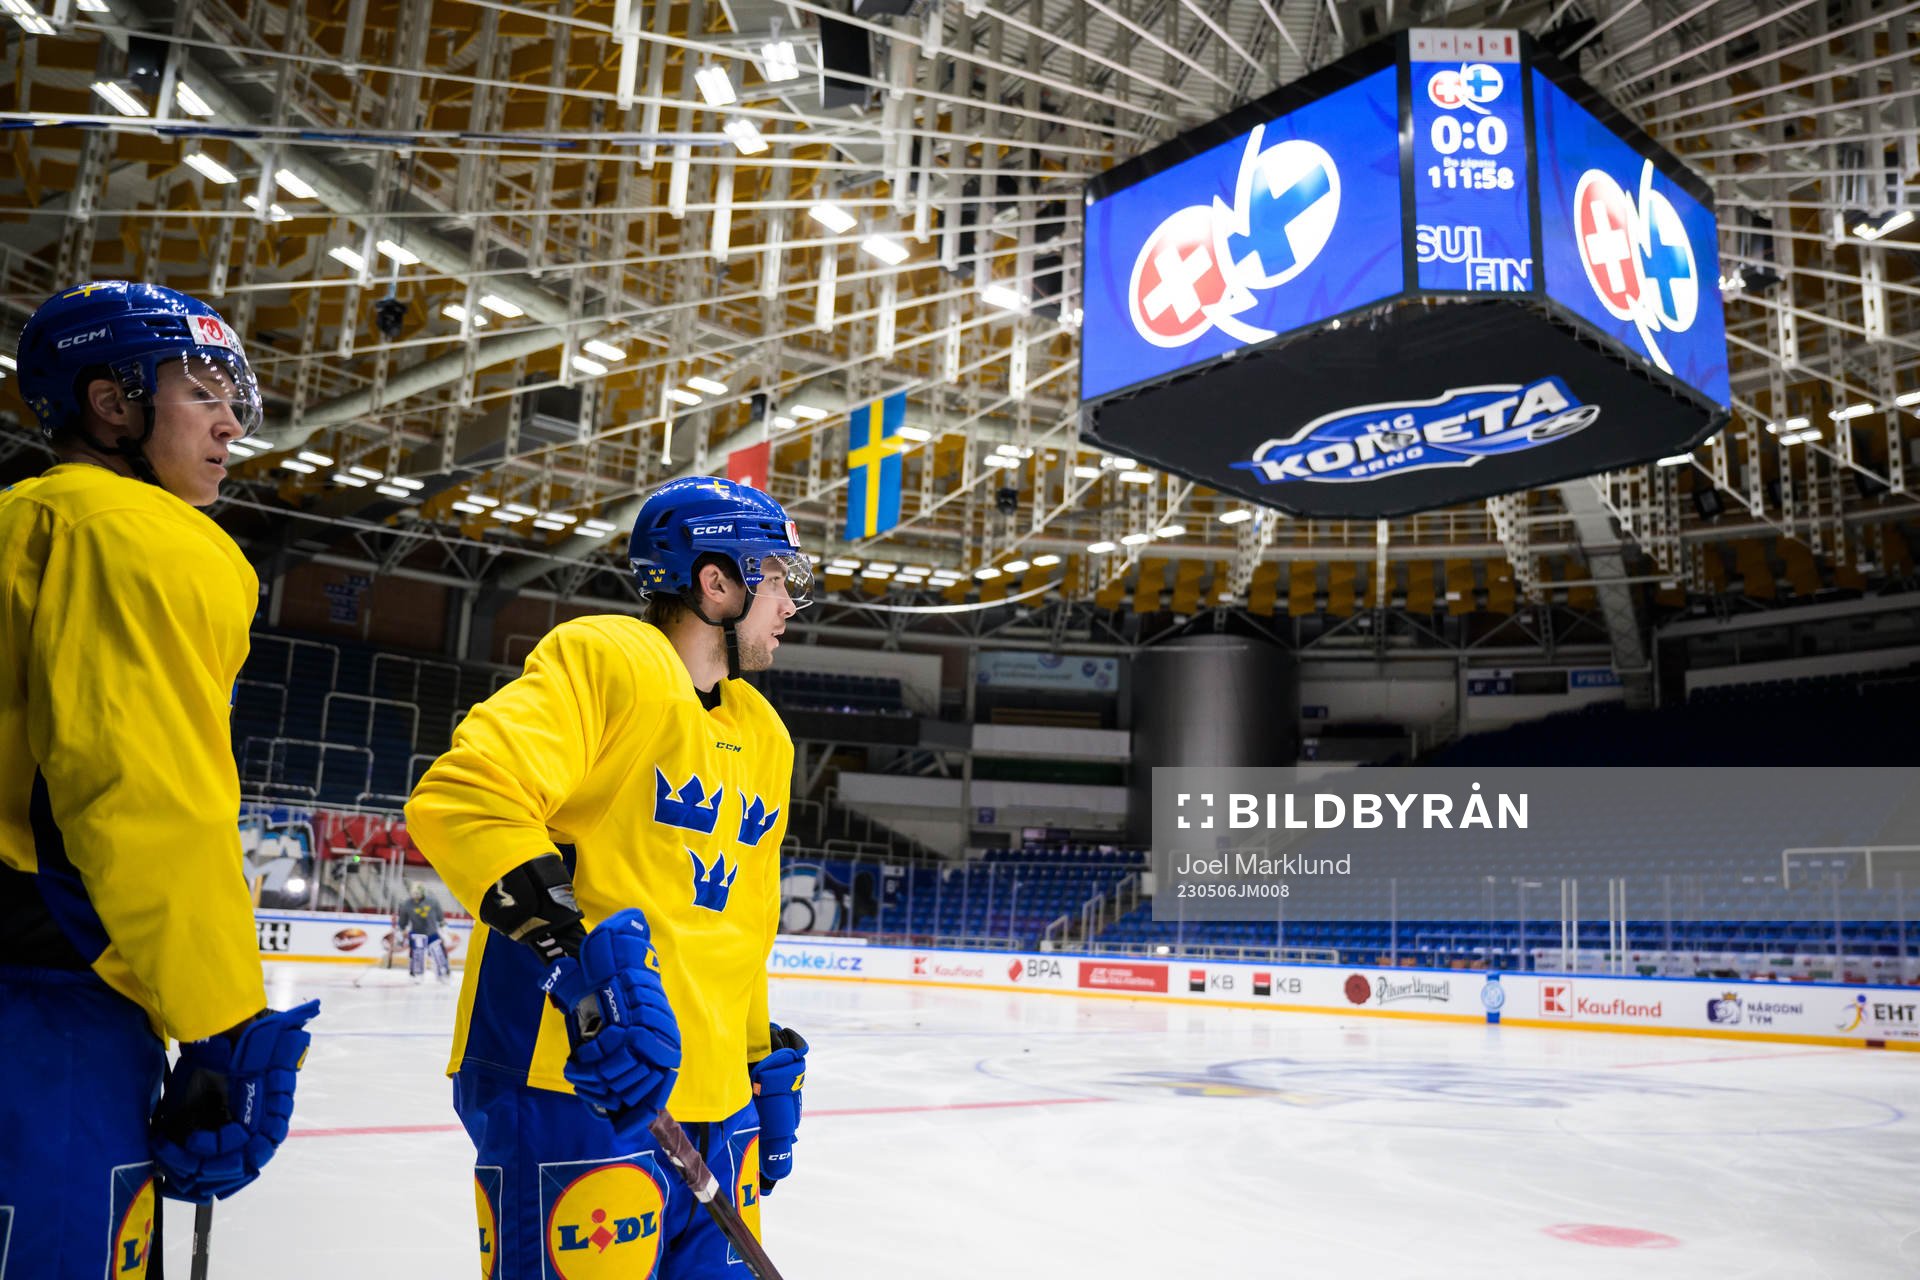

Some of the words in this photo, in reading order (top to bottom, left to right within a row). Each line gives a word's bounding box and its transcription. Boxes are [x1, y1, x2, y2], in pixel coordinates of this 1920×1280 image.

[1430, 115, 1508, 155] 0:0
[1428, 166, 1515, 190] 111:58
[1416, 224, 1482, 263] SUI
[1465, 258, 1533, 292] FIN
[57, 328, 107, 349] CCM
[1366, 413, 1415, 434] HC
[1350, 447, 1424, 476] BRNO
[693, 524, 733, 536] CCM
[715, 741, 742, 753] CCM
[773, 950, 863, 972] hokej.cz
[1027, 959, 1062, 978] BPA
[1210, 974, 1234, 990] KB
[1276, 977, 1302, 994] KB
[1577, 996, 1662, 1019] Kaufland
[1873, 1003, 1917, 1021] EHT
